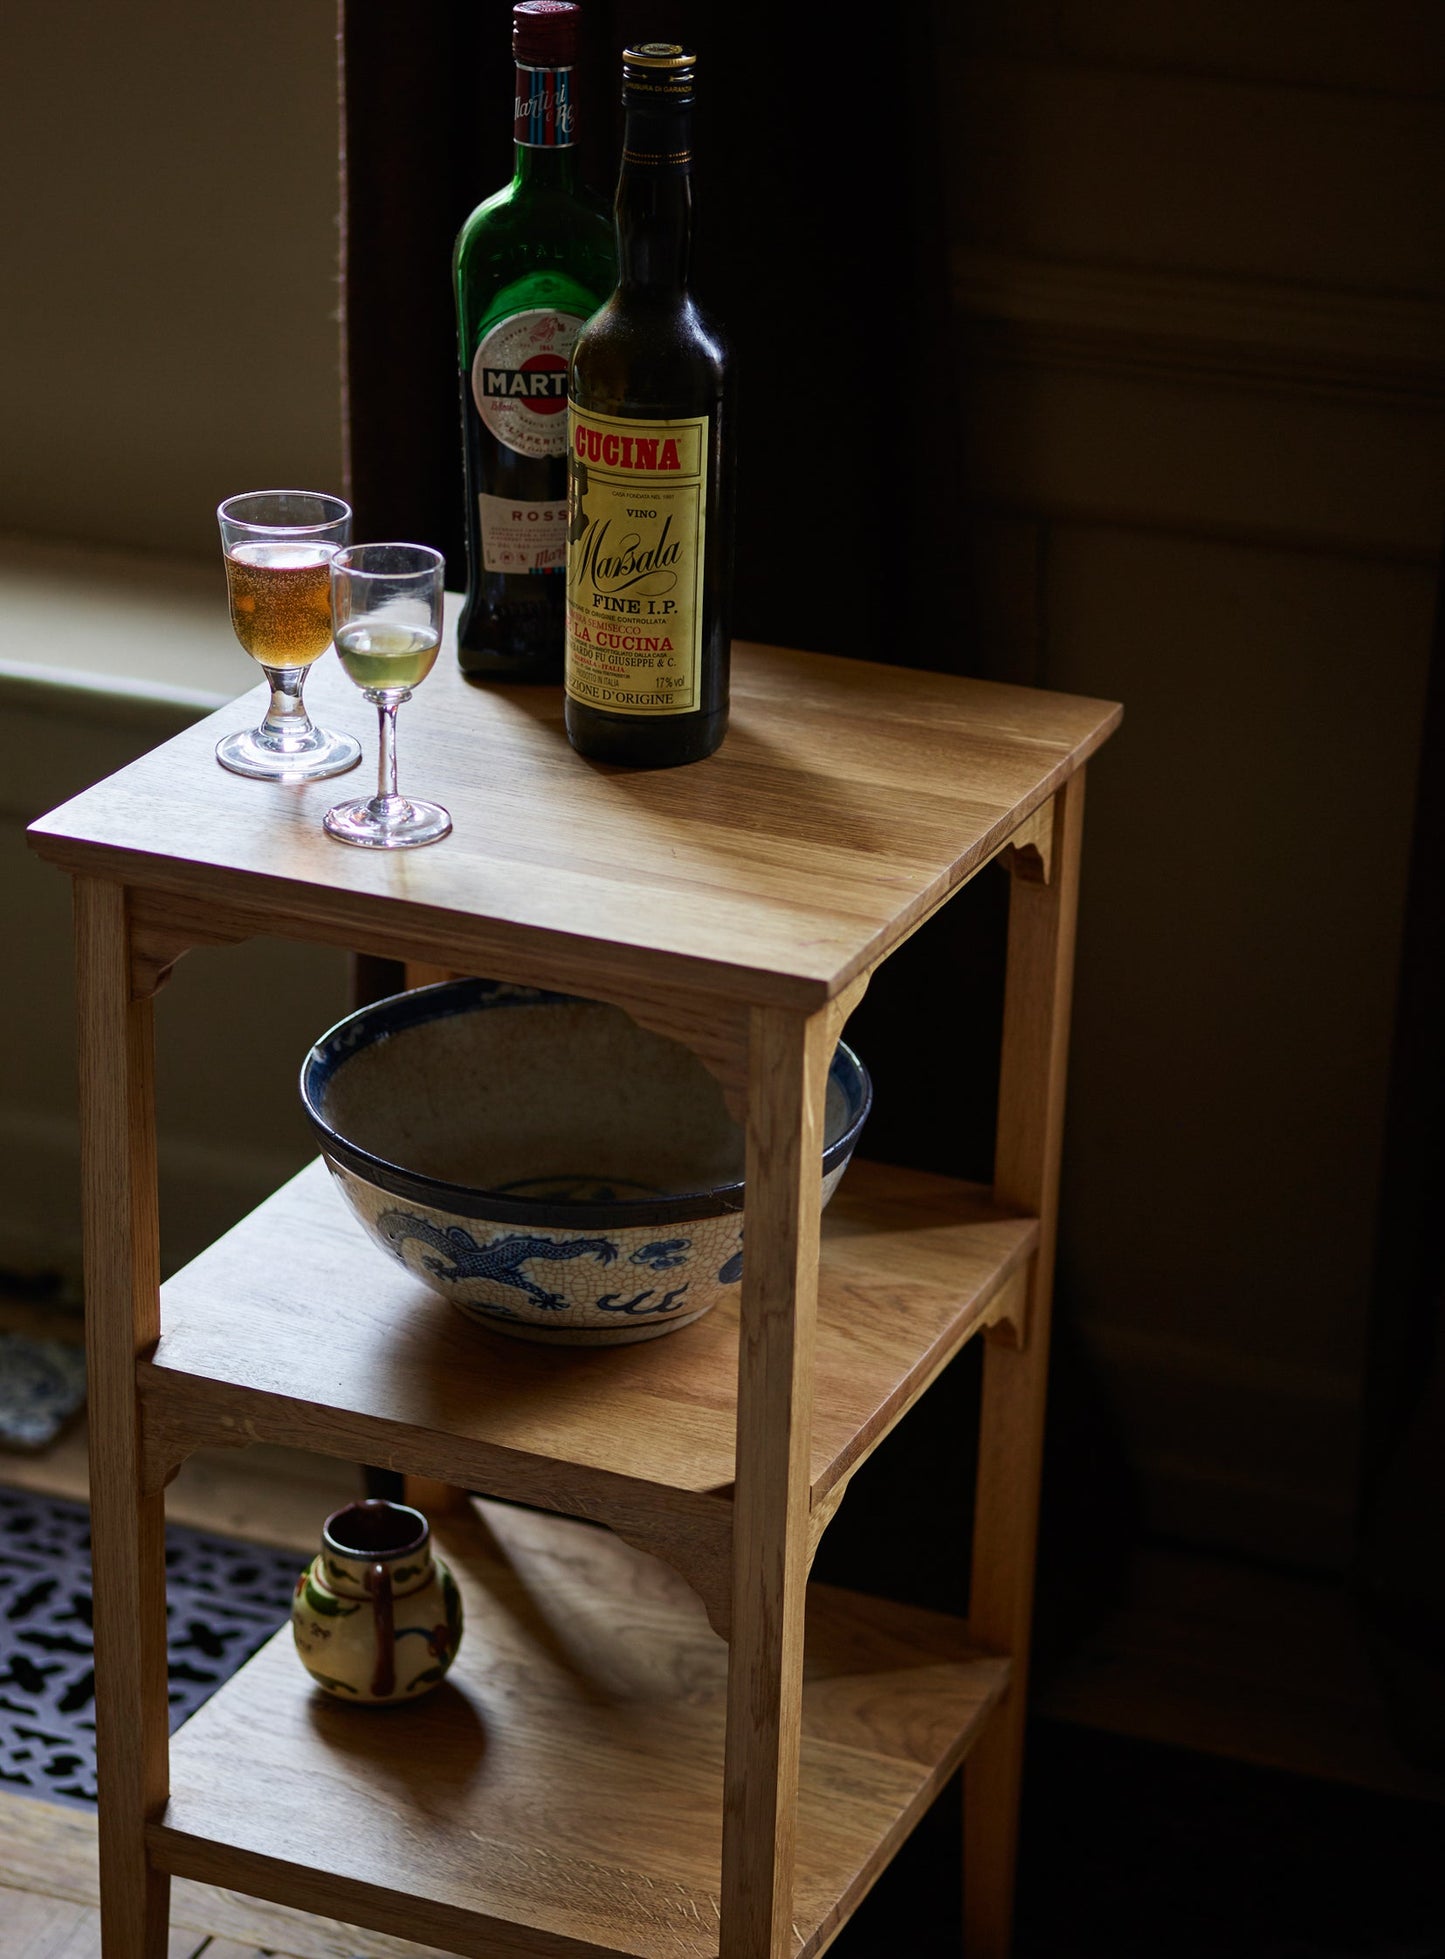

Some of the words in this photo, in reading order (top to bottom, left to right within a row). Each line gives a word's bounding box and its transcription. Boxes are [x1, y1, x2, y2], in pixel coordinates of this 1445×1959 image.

[626, 508, 658, 519] VINO
[569, 514, 684, 597] Marsala
[592, 593, 641, 615] FINE
[647, 599, 679, 615] I.P.
[588, 618, 642, 636] SEMISECCO
[617, 616, 668, 625] CONTROLLATA
[574, 622, 591, 643] LA
[596, 631, 674, 652] CUCINA
[595, 651, 606, 663] FU
[608, 655, 654, 668] GIUSEPPE
[657, 658, 664, 668] &
[667, 657, 677, 667] C.
[601, 664, 626, 674] ITALIA
[602, 690, 674, 706] D'ORIGINE
